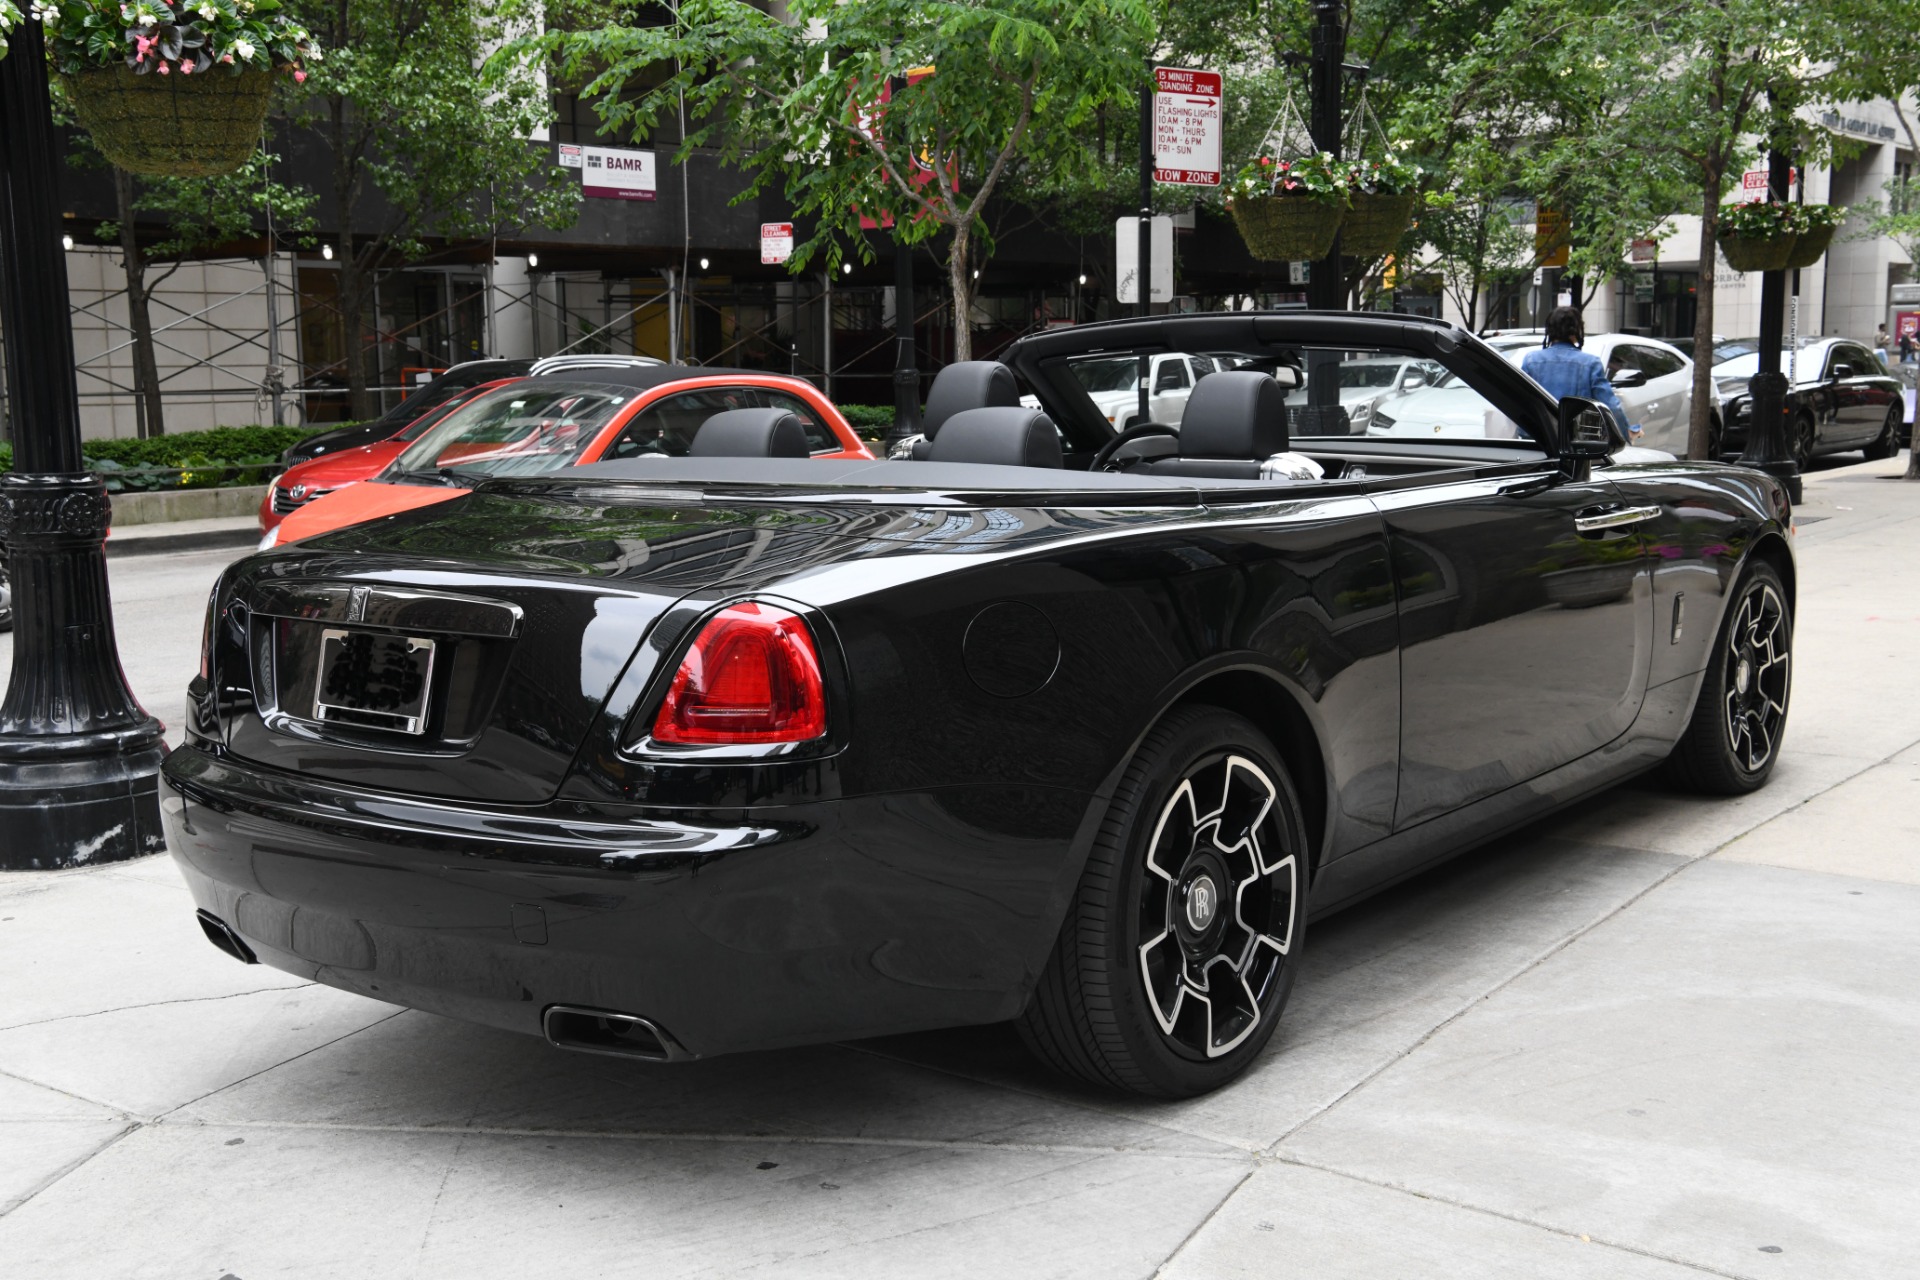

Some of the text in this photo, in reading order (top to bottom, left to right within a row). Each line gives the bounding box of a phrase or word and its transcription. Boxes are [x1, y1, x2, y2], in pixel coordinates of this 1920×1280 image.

[1159, 71, 1194, 82] 15 MINUTE
[1159, 81, 1215, 94] STANDING ZONE
[1158, 96, 1173, 105] USE
[1158, 106, 1217, 118] FLASHING LIGHTS
[1158, 125, 1174, 134] MON
[1182, 127, 1206, 136] THURS
[1158, 144, 1170, 153] FRI
[1177, 145, 1192, 154] SUN
[606, 157, 642, 171] BAMR
[1158, 169, 1215, 183] TOW ZONE
